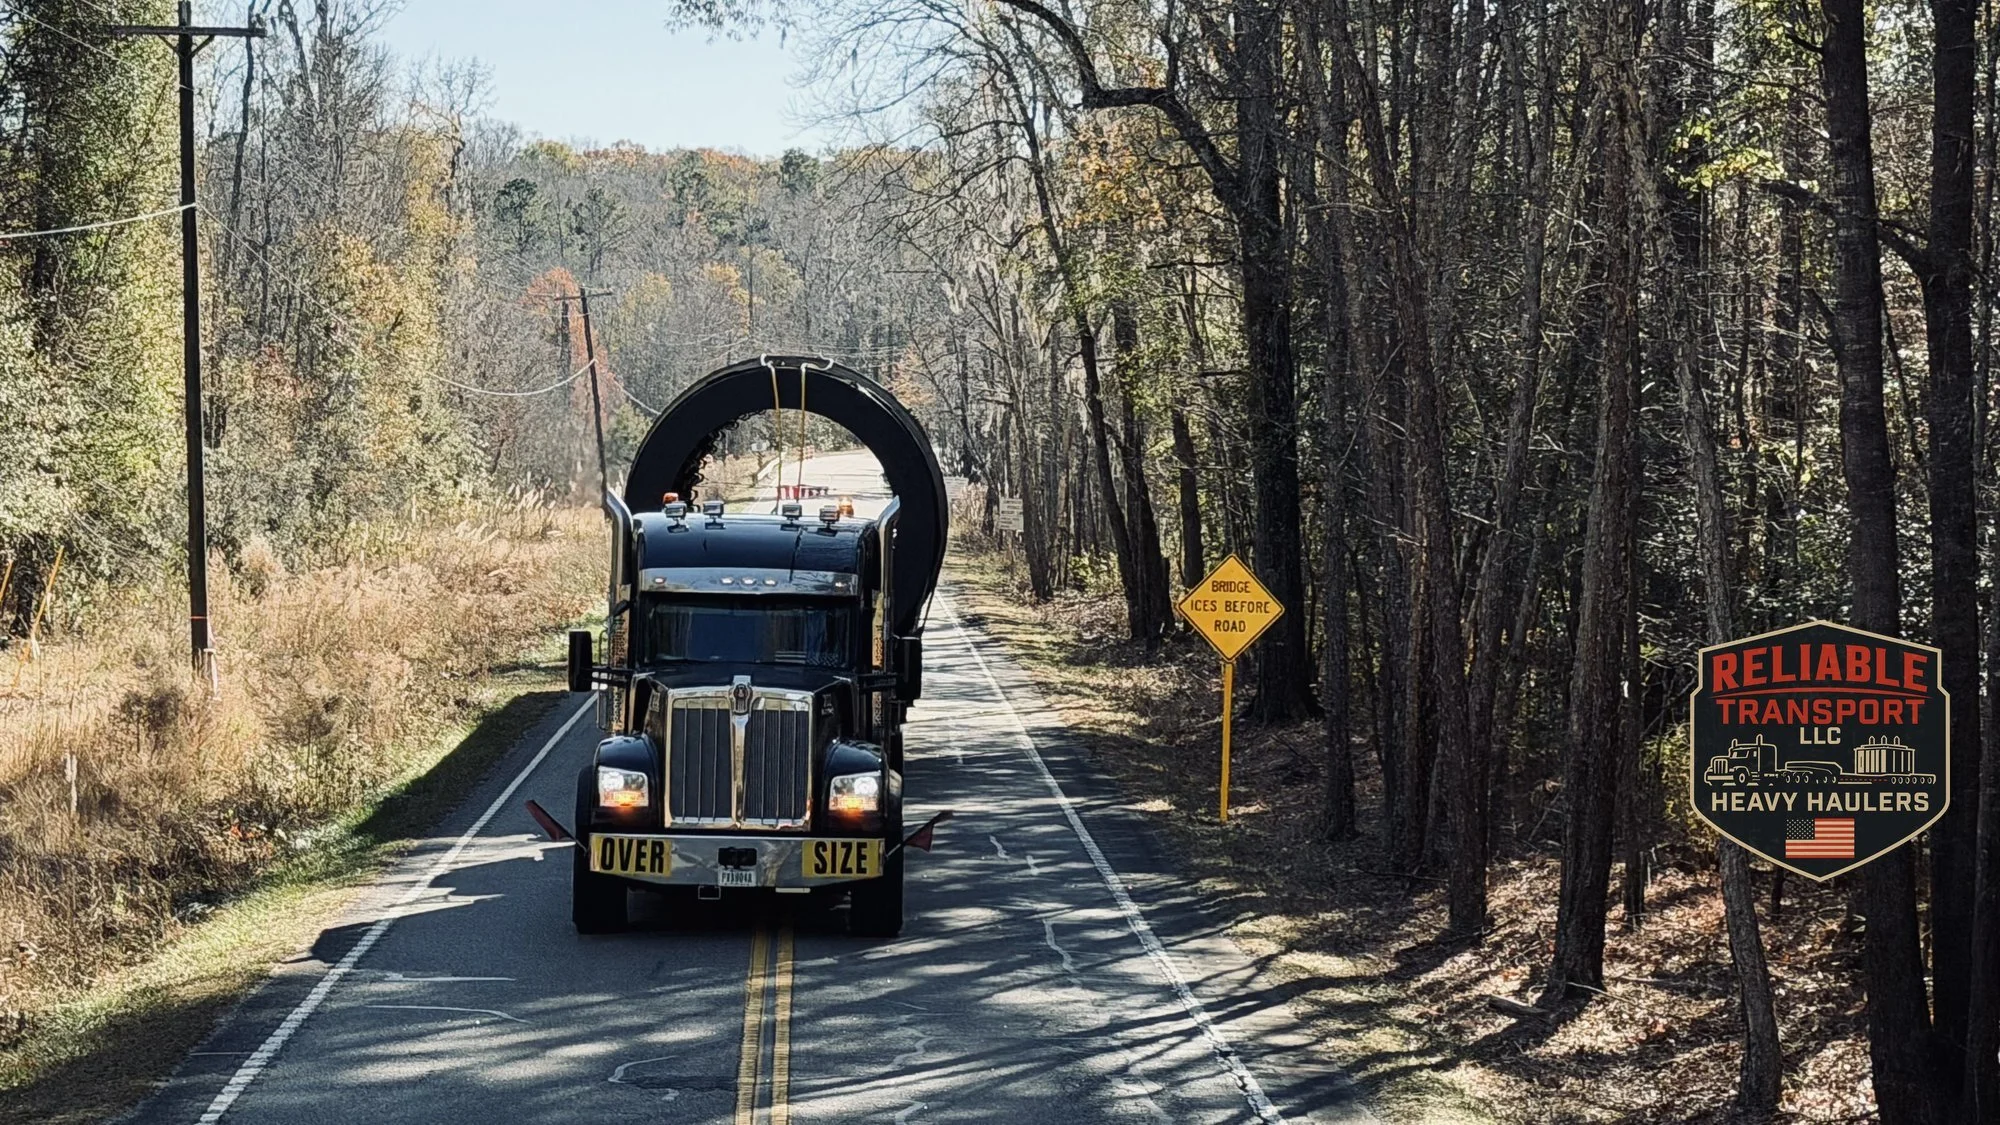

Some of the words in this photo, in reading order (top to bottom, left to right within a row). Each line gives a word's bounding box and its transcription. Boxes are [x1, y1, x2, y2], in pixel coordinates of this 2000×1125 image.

[1211, 581, 1251, 593] BRIDGE
[1190, 600, 1217, 612] ICES
[1225, 601, 1270, 613] BEFORE
[1214, 620, 1246, 632] ROAD
[601, 838, 664, 873] OVER
[814, 840, 867, 875] SIZE
